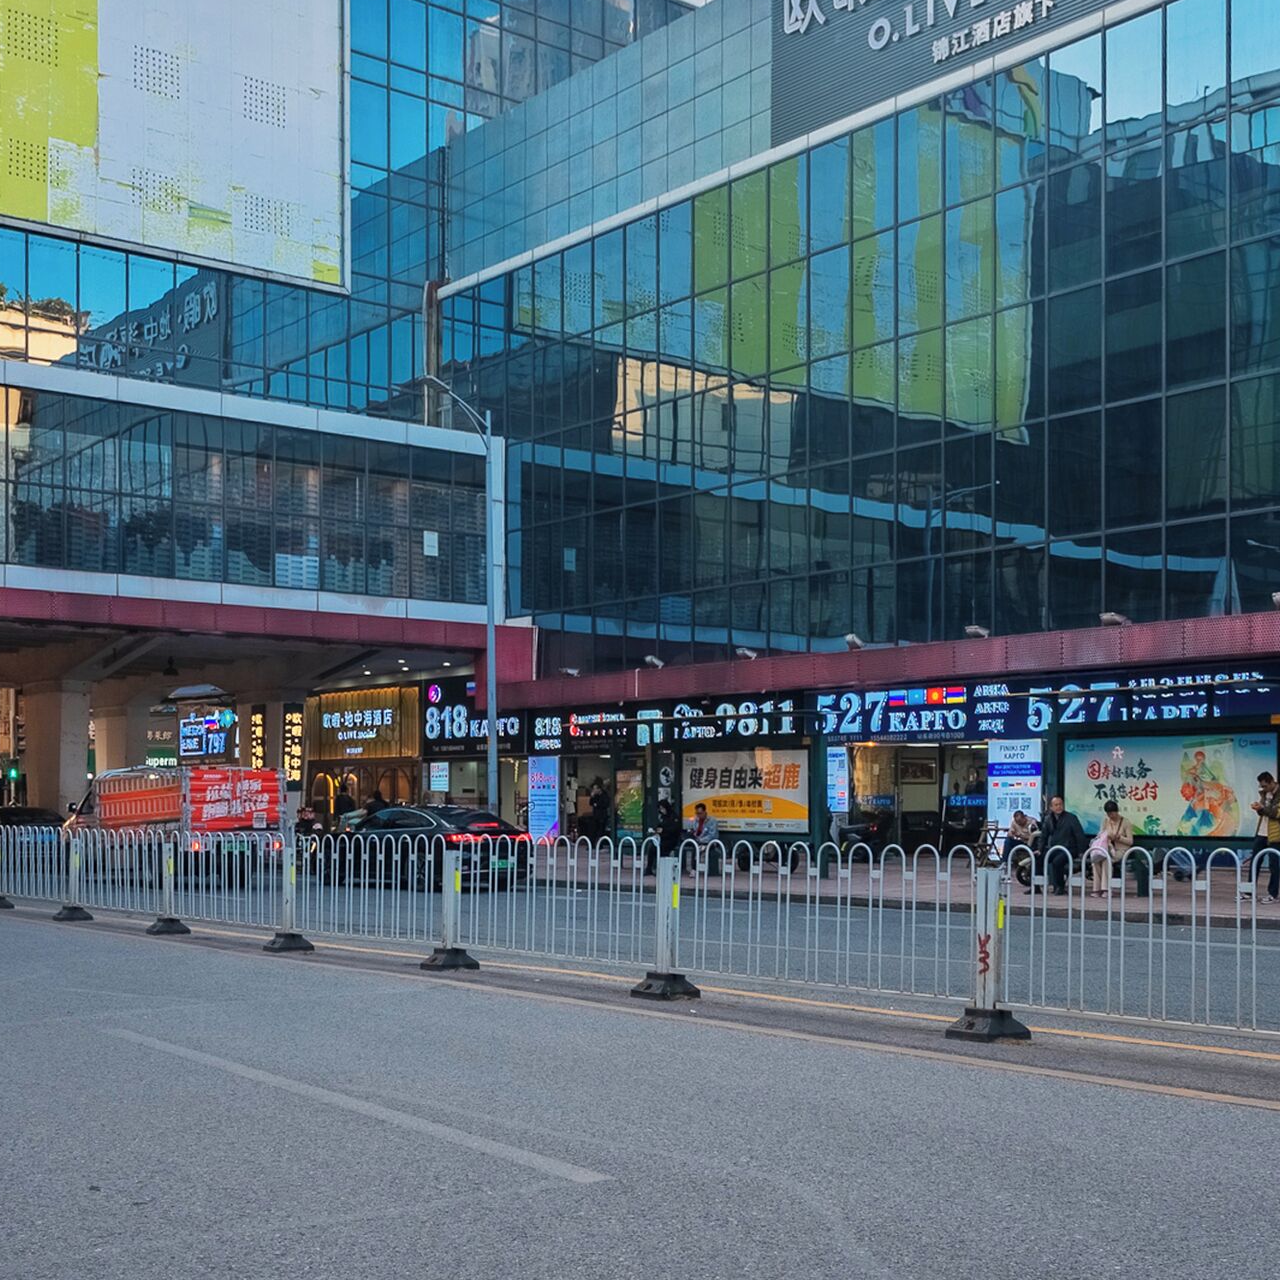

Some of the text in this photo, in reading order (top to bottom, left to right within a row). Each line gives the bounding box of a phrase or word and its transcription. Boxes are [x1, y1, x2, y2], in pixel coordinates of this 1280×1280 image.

[425, 704, 520, 740] 818 КАГО
[815, 690, 968, 734] 527 КАРГО
[1026, 681, 1120, 732] 527
[534, 716, 562, 737] 818
[689, 762, 801, 791] 健身自由来超鹿
